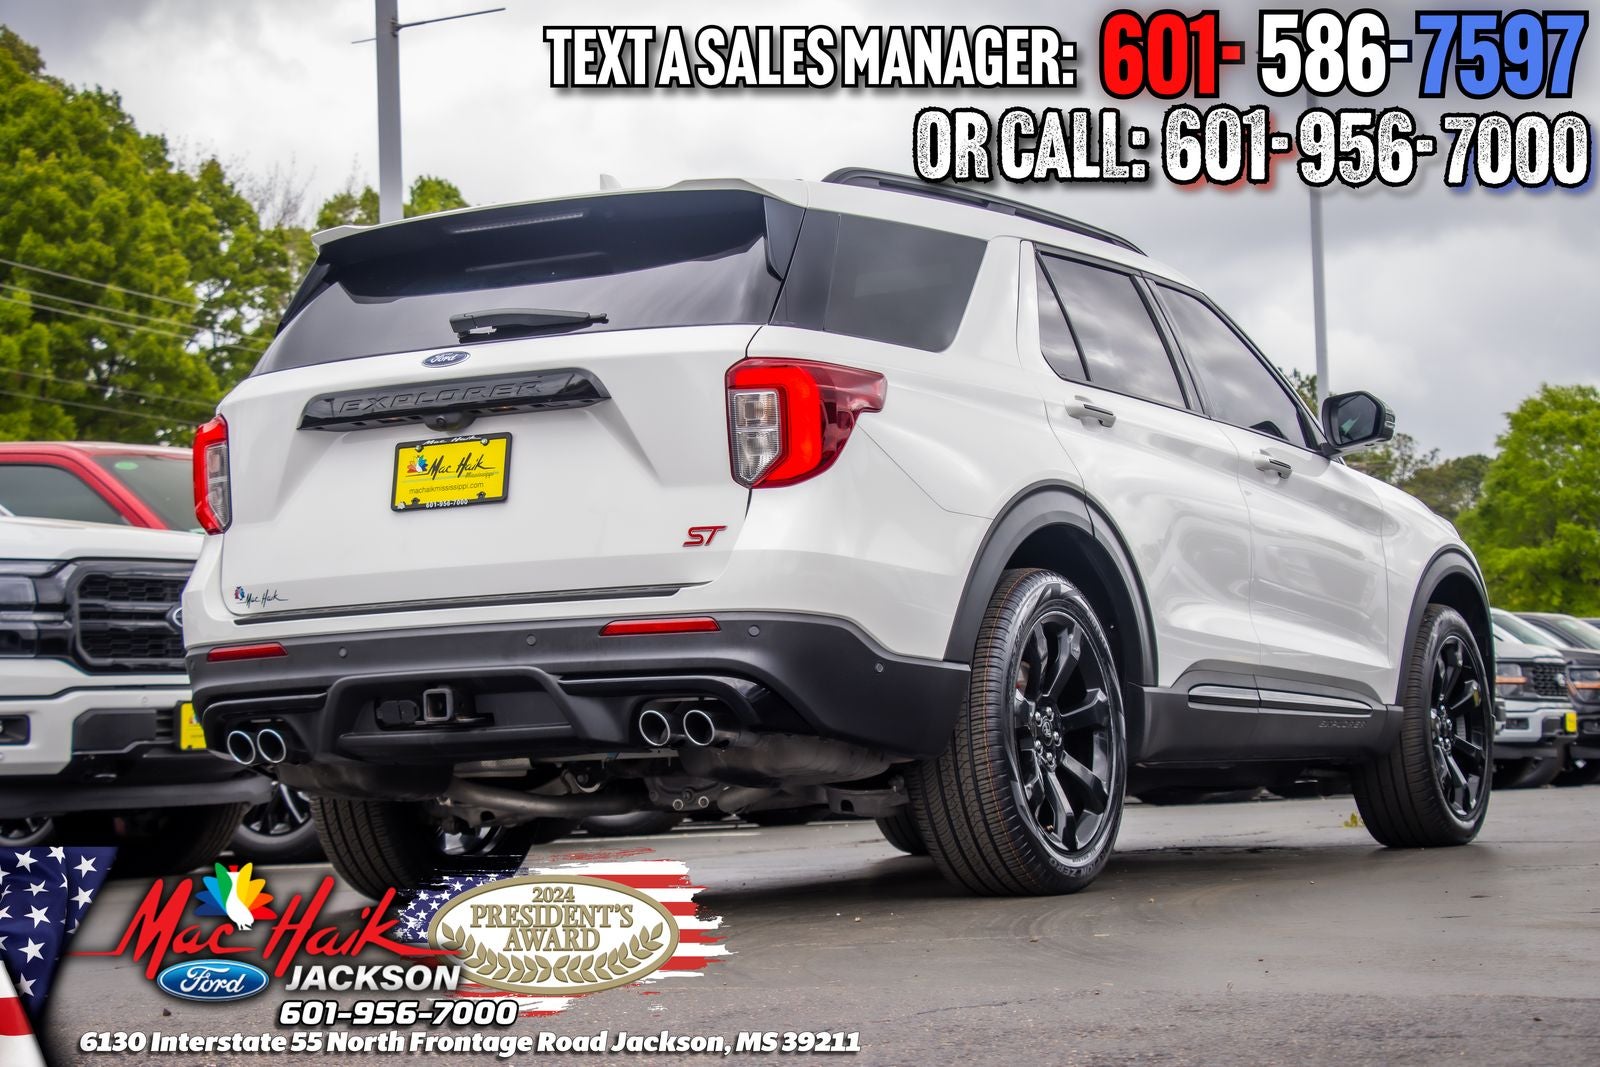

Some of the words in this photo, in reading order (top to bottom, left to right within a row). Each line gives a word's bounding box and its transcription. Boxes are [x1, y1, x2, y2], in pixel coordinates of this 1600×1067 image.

[339, 380, 544, 414] EXPLORER
[427, 454, 454, 481] Mac
[455, 452, 492, 479] Haik
[408, 481, 485, 495] machaikmississippi.com
[682, 524, 728, 547] ST
